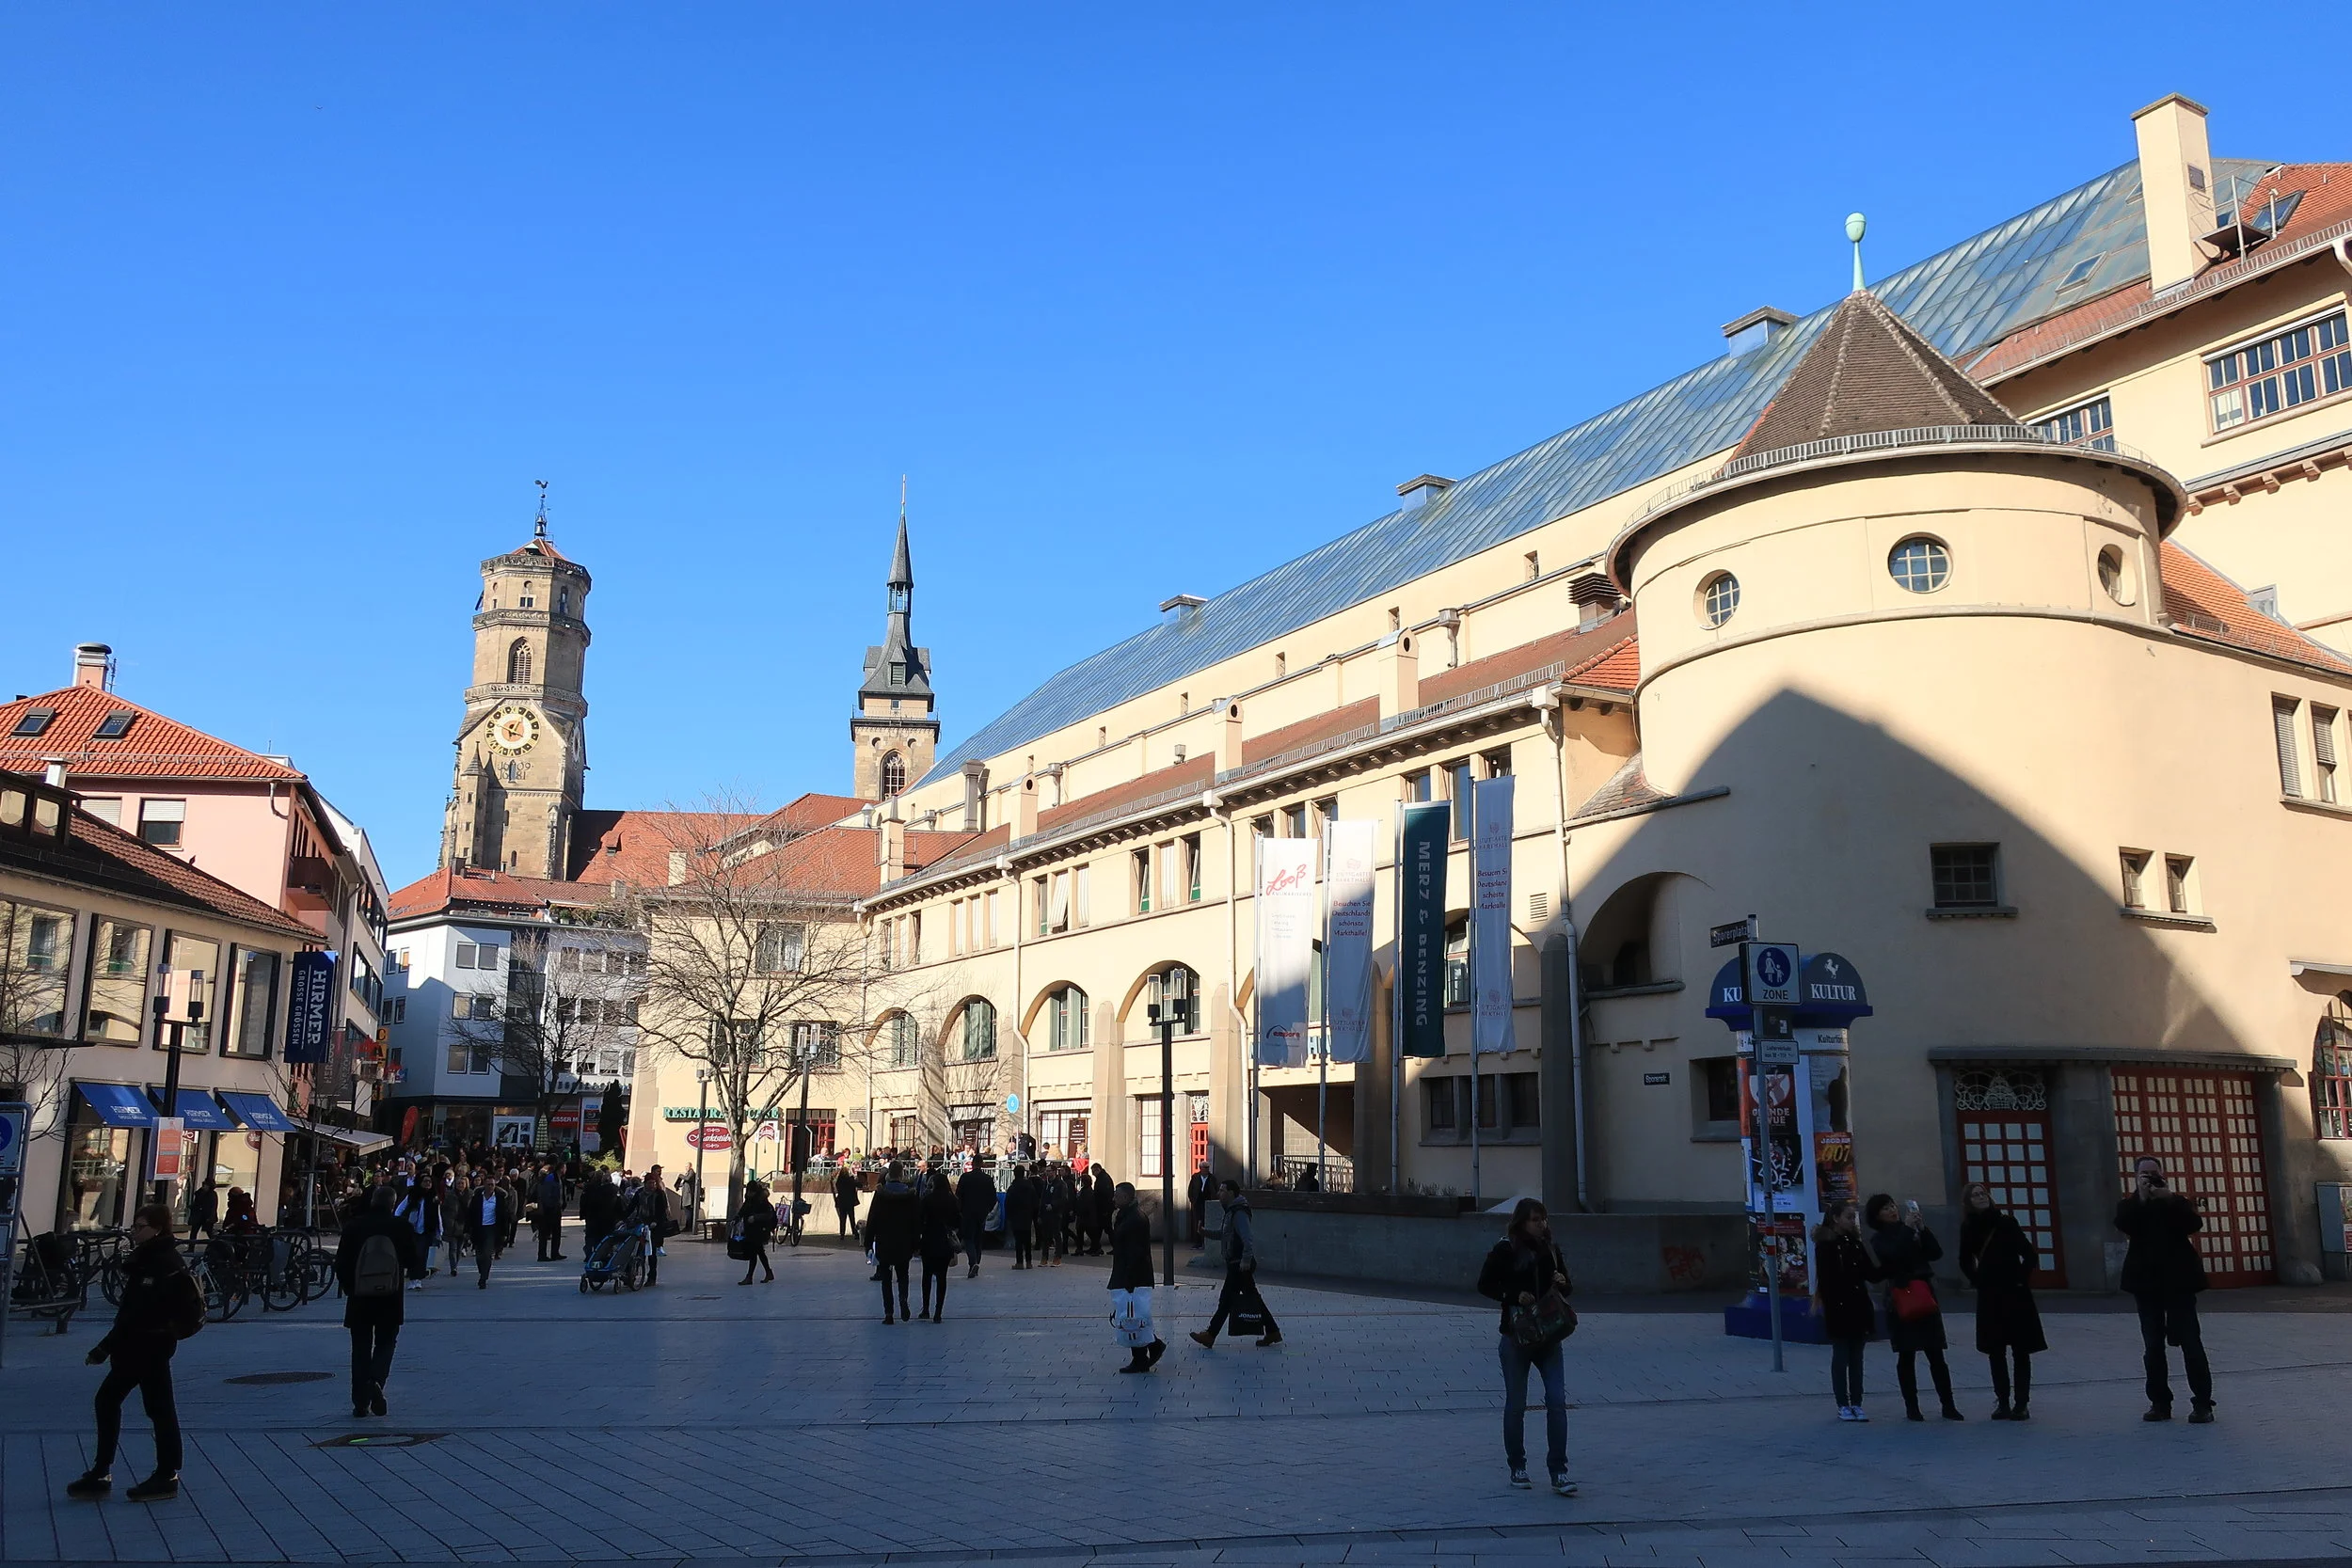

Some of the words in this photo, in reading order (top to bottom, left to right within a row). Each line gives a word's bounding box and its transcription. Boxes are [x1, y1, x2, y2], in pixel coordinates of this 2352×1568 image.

[1419, 841, 1431, 900] MERZ
[1712, 926, 1748, 942] Sporerplatz
[296, 970, 307, 1003] GROSSE
[1416, 934, 1428, 1026] BENZING
[1810, 984, 1857, 1001] KULTUR
[308, 970, 326, 1044] HIRMER
[1724, 987, 1743, 1003] KU
[1763, 990, 1788, 1000] ZONE
[293, 1006, 304, 1044] GRÖSSEN
[662, 1107, 726, 1119] RESTAURA
